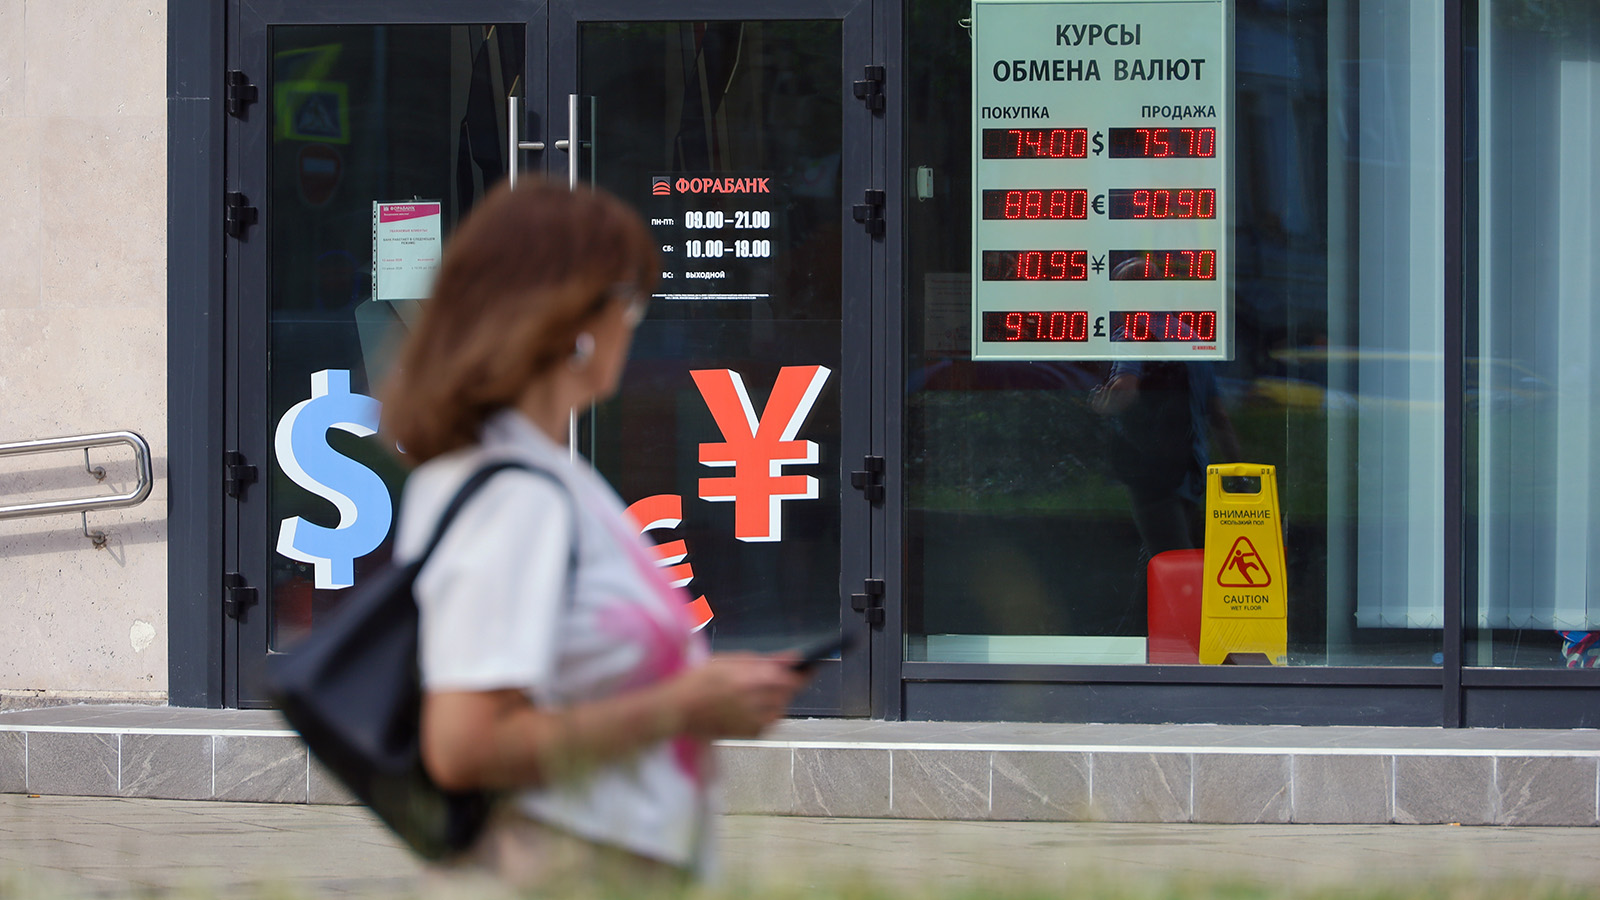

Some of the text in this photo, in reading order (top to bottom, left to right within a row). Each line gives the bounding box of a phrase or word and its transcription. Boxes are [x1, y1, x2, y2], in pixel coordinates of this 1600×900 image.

[1057, 24, 1140, 46] КУРСЫ
[993, 59, 1205, 81] ОБМЕНА ВАЛЮТ
[982, 107, 1049, 119] ПОКУПКА
[1142, 106, 1216, 120] ПРОДАЖА
[1009, 130, 1086, 157] 74.00
[1137, 129, 1214, 156] 75.70
[676, 178, 769, 193] ФОРАБАНК
[1005, 191, 1086, 218] 88.80
[1134, 190, 1214, 217] 90.90
[1018, 252, 1085, 279] 10.95
[1145, 251, 1215, 278] 11.70
[686, 271, 725, 279] ВЫХОДНОЙ
[1006, 312, 1086, 340] 97.00
[1125, 312, 1214, 340] 101.00
[1214, 510, 1270, 518] ВНИМАНИЕ
[1224, 595, 1268, 603] CAUTION
